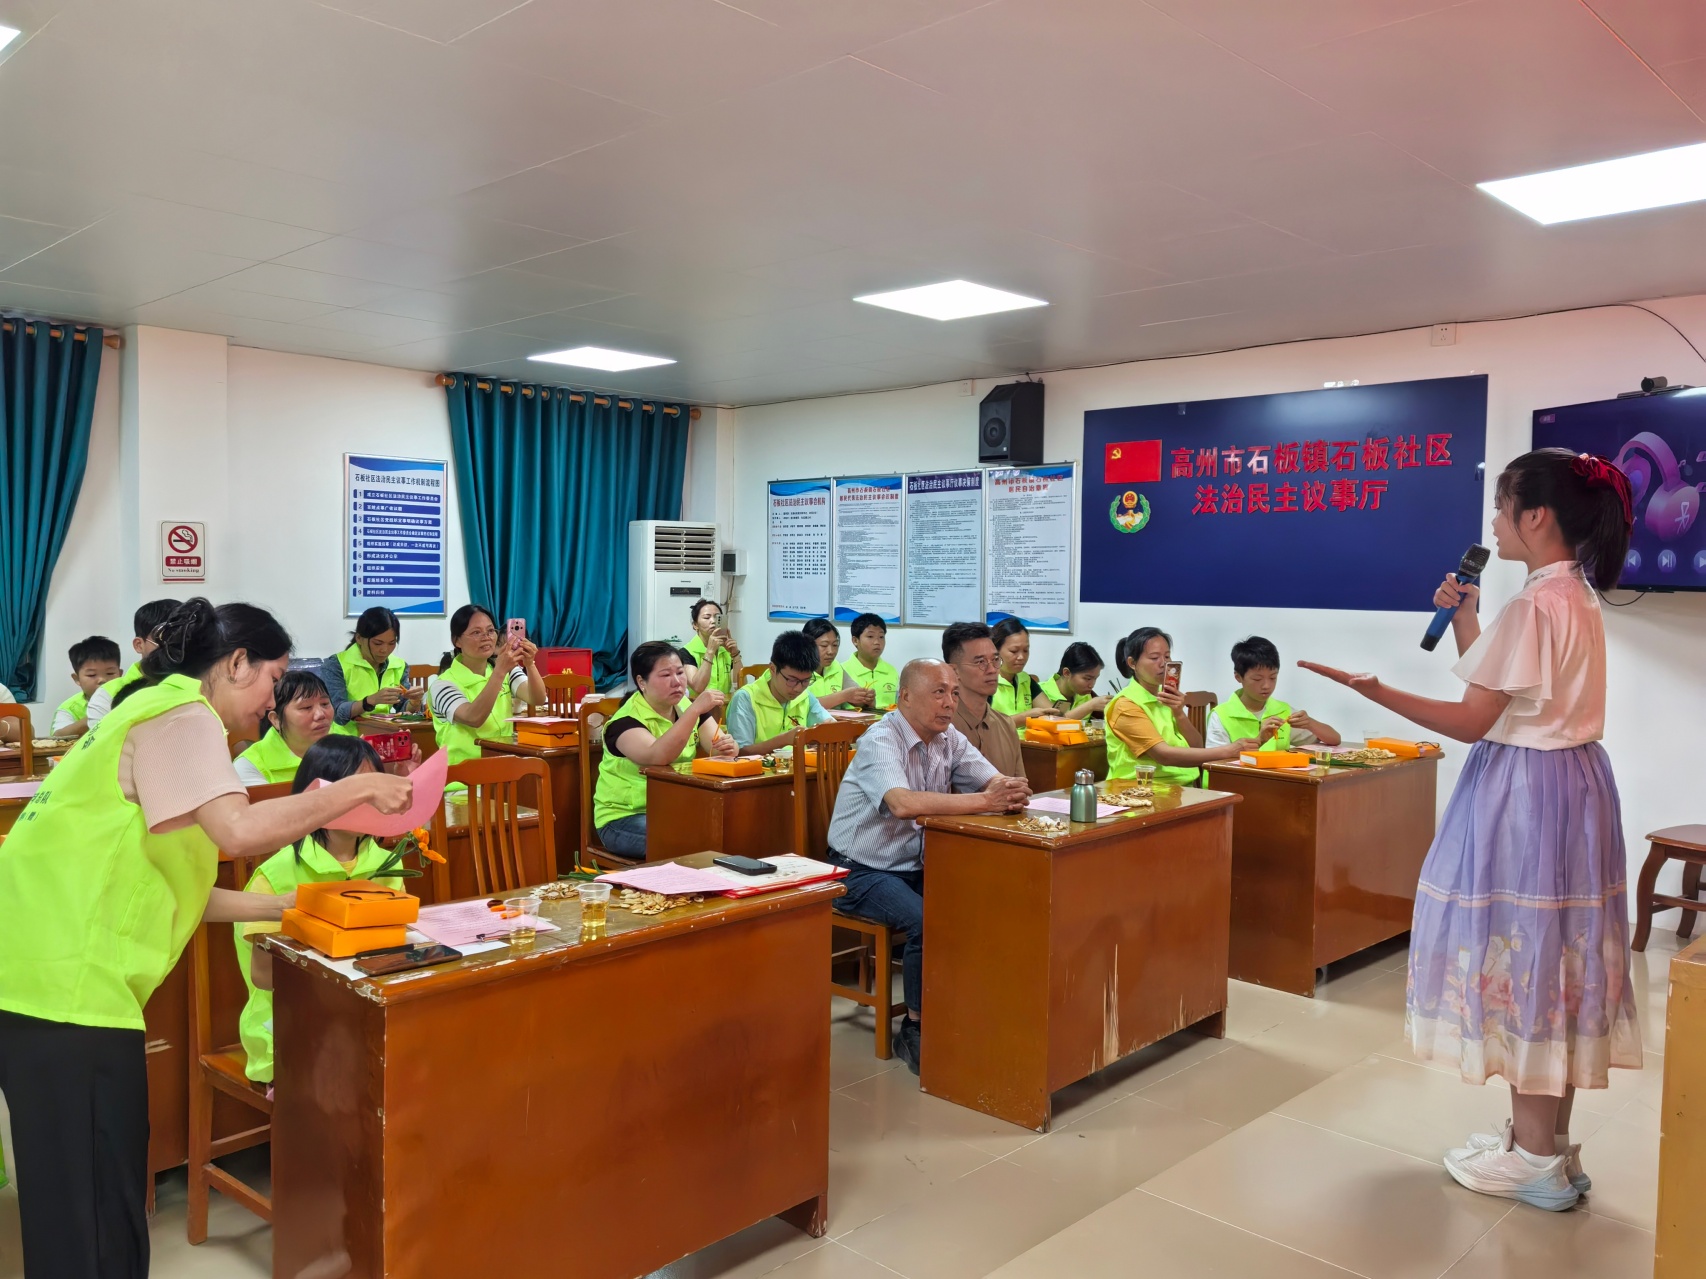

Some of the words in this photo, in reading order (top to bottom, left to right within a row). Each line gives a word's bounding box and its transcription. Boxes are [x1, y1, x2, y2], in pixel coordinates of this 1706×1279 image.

[1170, 433, 1453, 478] 高州市石板镇石板社区
[1191, 478, 1389, 515] 法治民主议事厅
